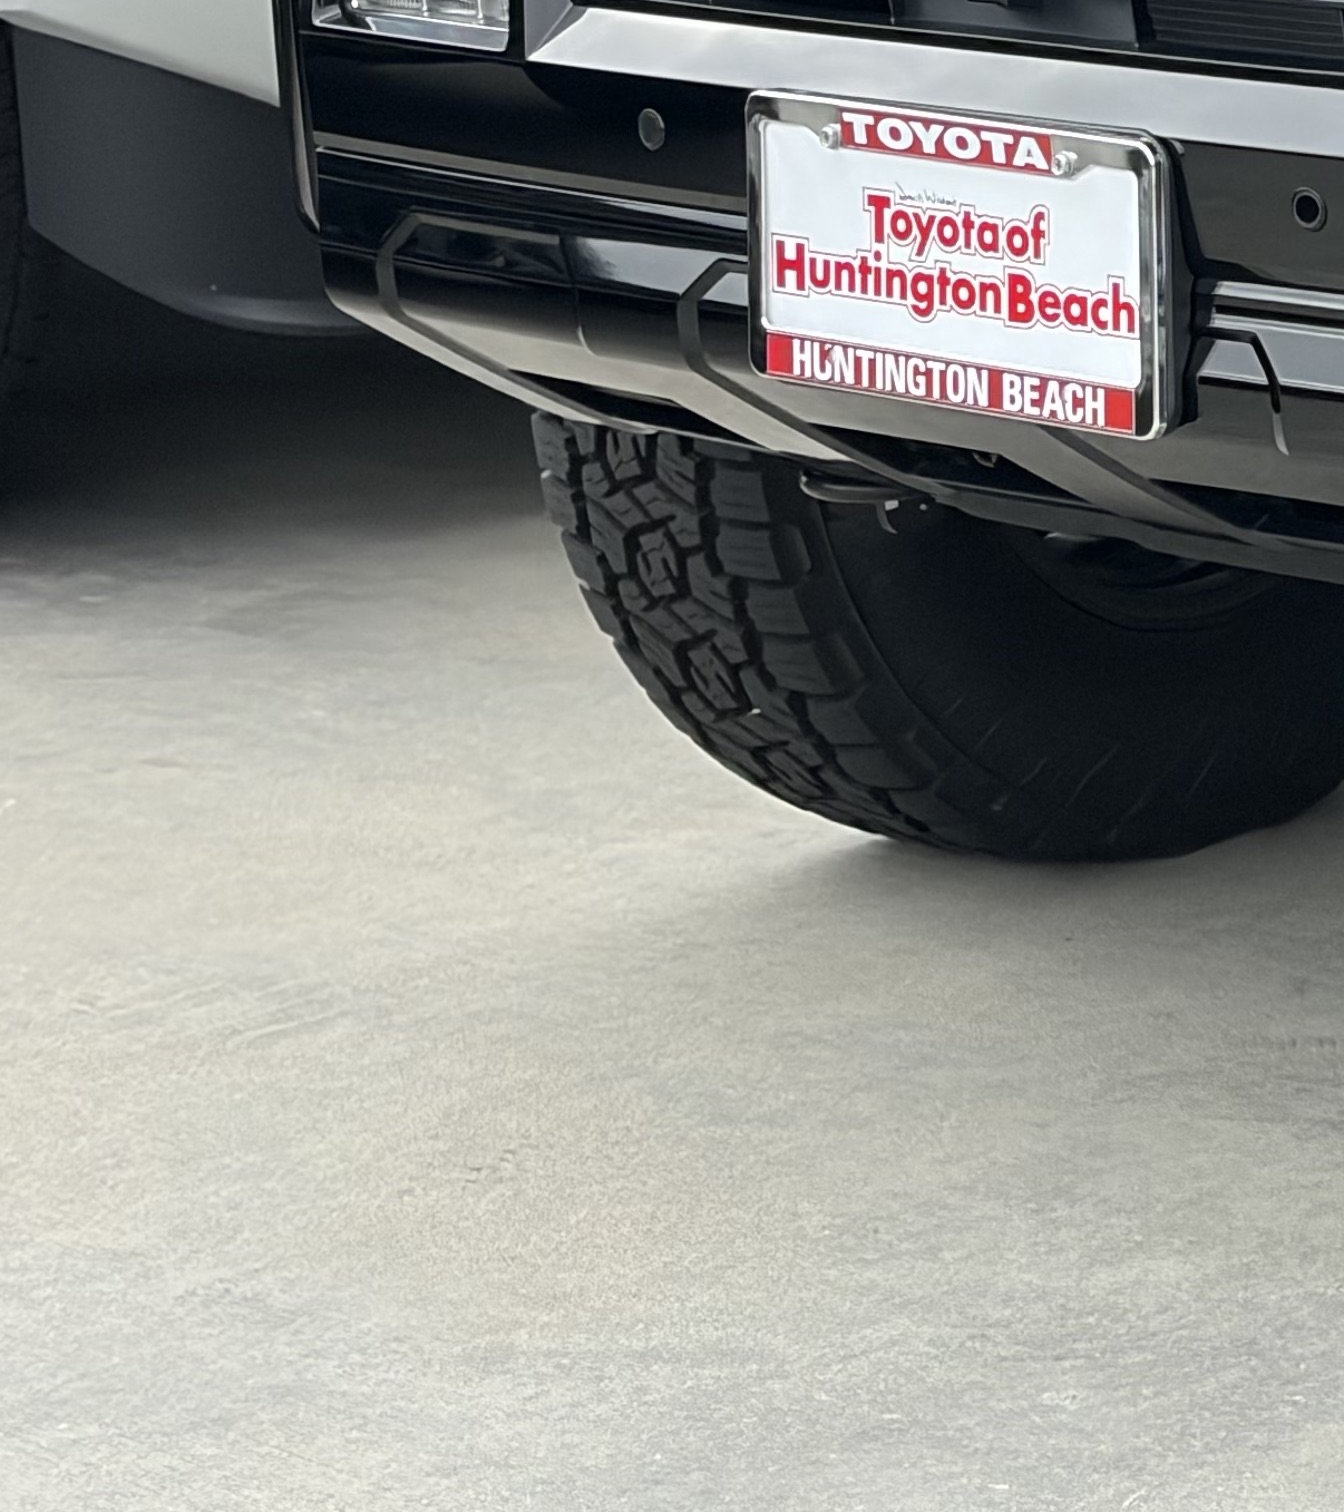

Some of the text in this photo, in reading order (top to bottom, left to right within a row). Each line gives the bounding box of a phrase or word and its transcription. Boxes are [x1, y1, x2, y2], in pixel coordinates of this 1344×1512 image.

[842, 111, 1050, 171] TOYOTA
[866, 194, 1046, 260] Toyota of
[774, 239, 1137, 335] Huntington Beach
[791, 338, 1106, 428] HUNTINGTON BEACH
